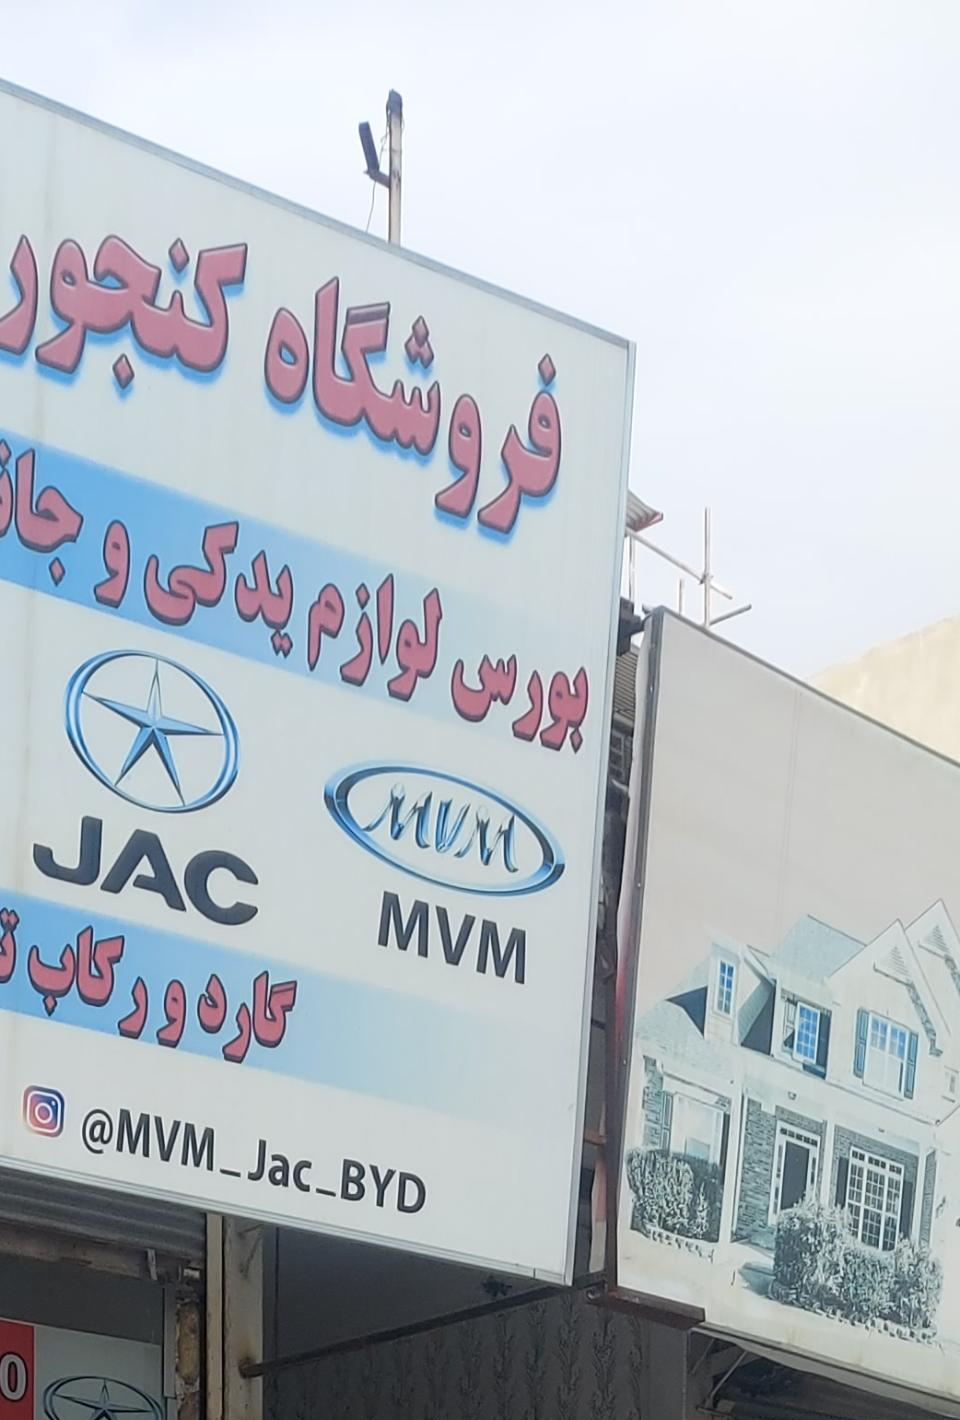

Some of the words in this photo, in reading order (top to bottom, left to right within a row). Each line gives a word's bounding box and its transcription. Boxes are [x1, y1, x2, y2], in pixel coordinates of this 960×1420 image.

[263, 277, 563, 534] فروشگاه
[93, 519, 132, 609] و
[142, 520, 295, 659] یدکی
[307, 573, 443, 703] لوازم
[450, 651, 590, 754] بورس
[32, 814, 260, 926] JAC
[361, 782, 521, 874] MVM
[26, 924, 148, 1040] رکاب
[376, 890, 528, 985] MVM
[155, 978, 186, 1048] و
[197, 969, 298, 1064] گارد
[81, 1107, 428, 1215] @MVM_Jac_BYD
